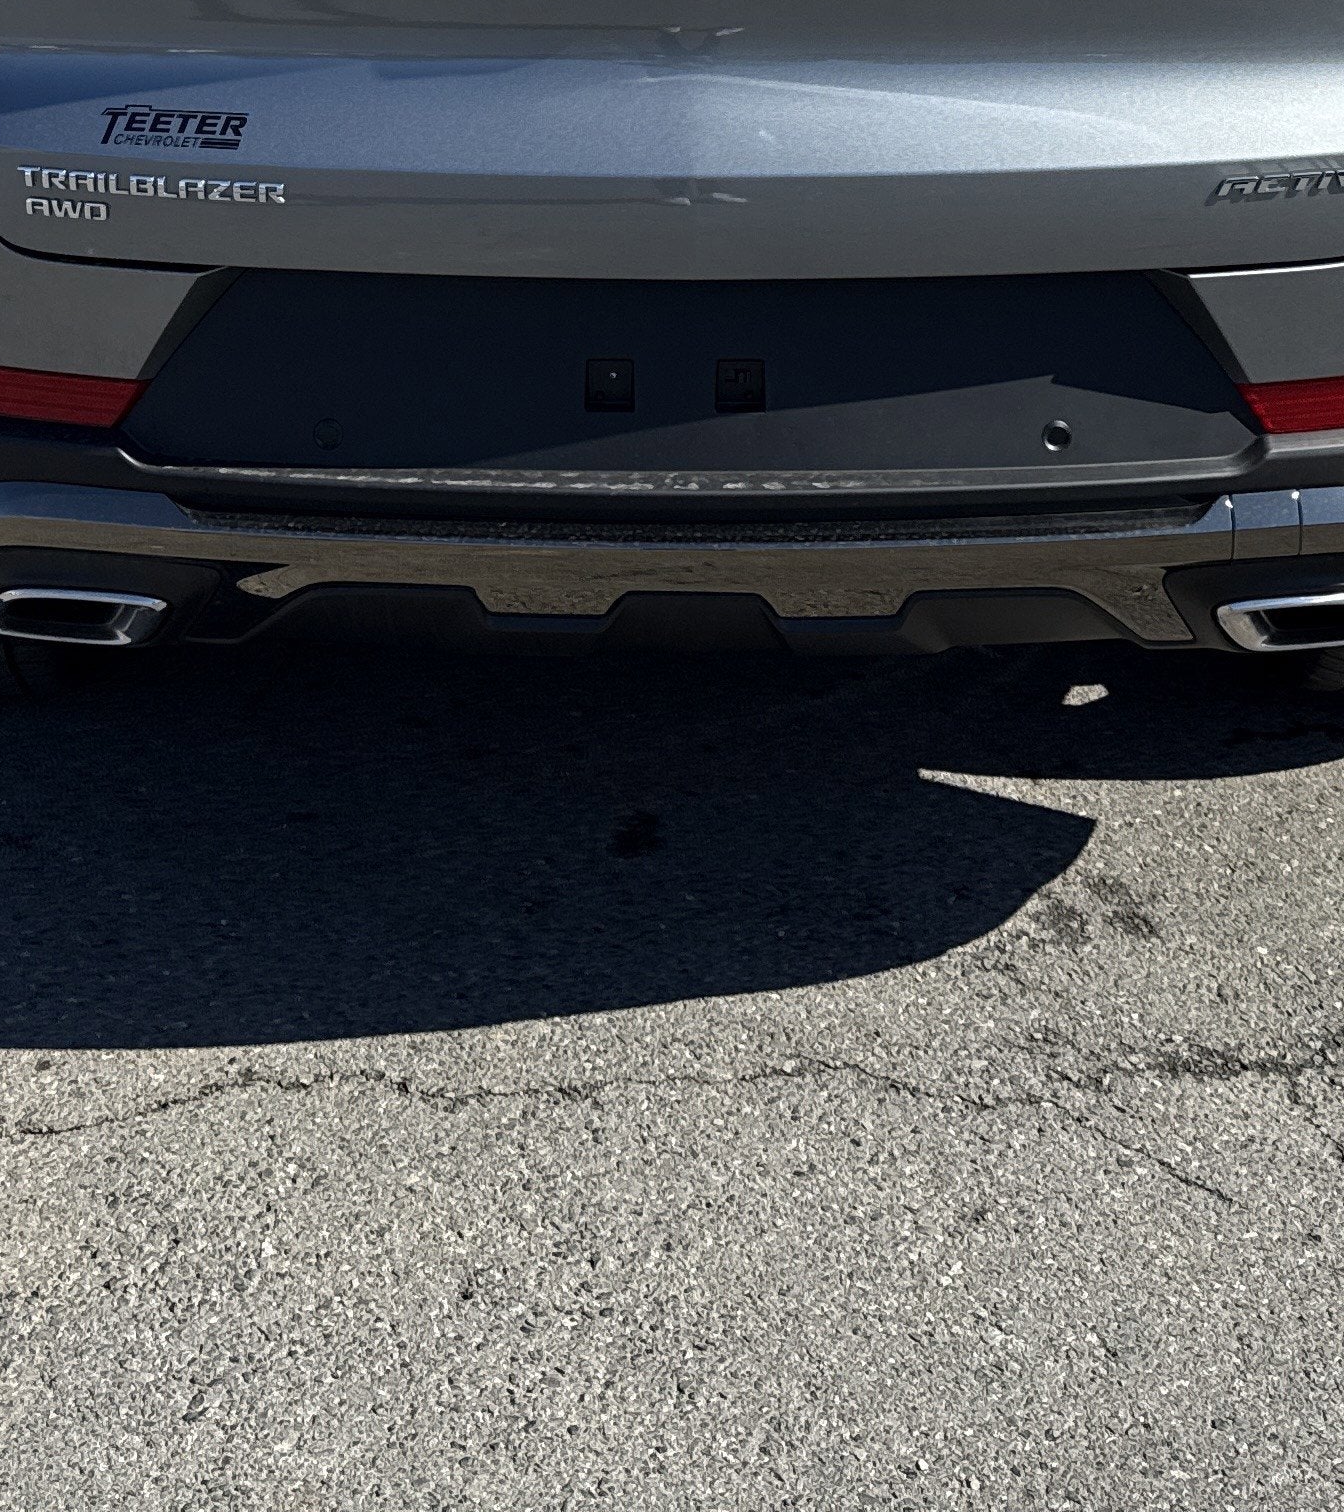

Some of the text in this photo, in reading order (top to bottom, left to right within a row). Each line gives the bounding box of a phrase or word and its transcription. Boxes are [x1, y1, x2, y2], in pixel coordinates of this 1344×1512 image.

[100, 105, 249, 145] TEETER
[113, 133, 201, 149] CHEVROLET
[17, 164, 287, 204] TRAILBLAZER
[25, 196, 108, 221] AWD
